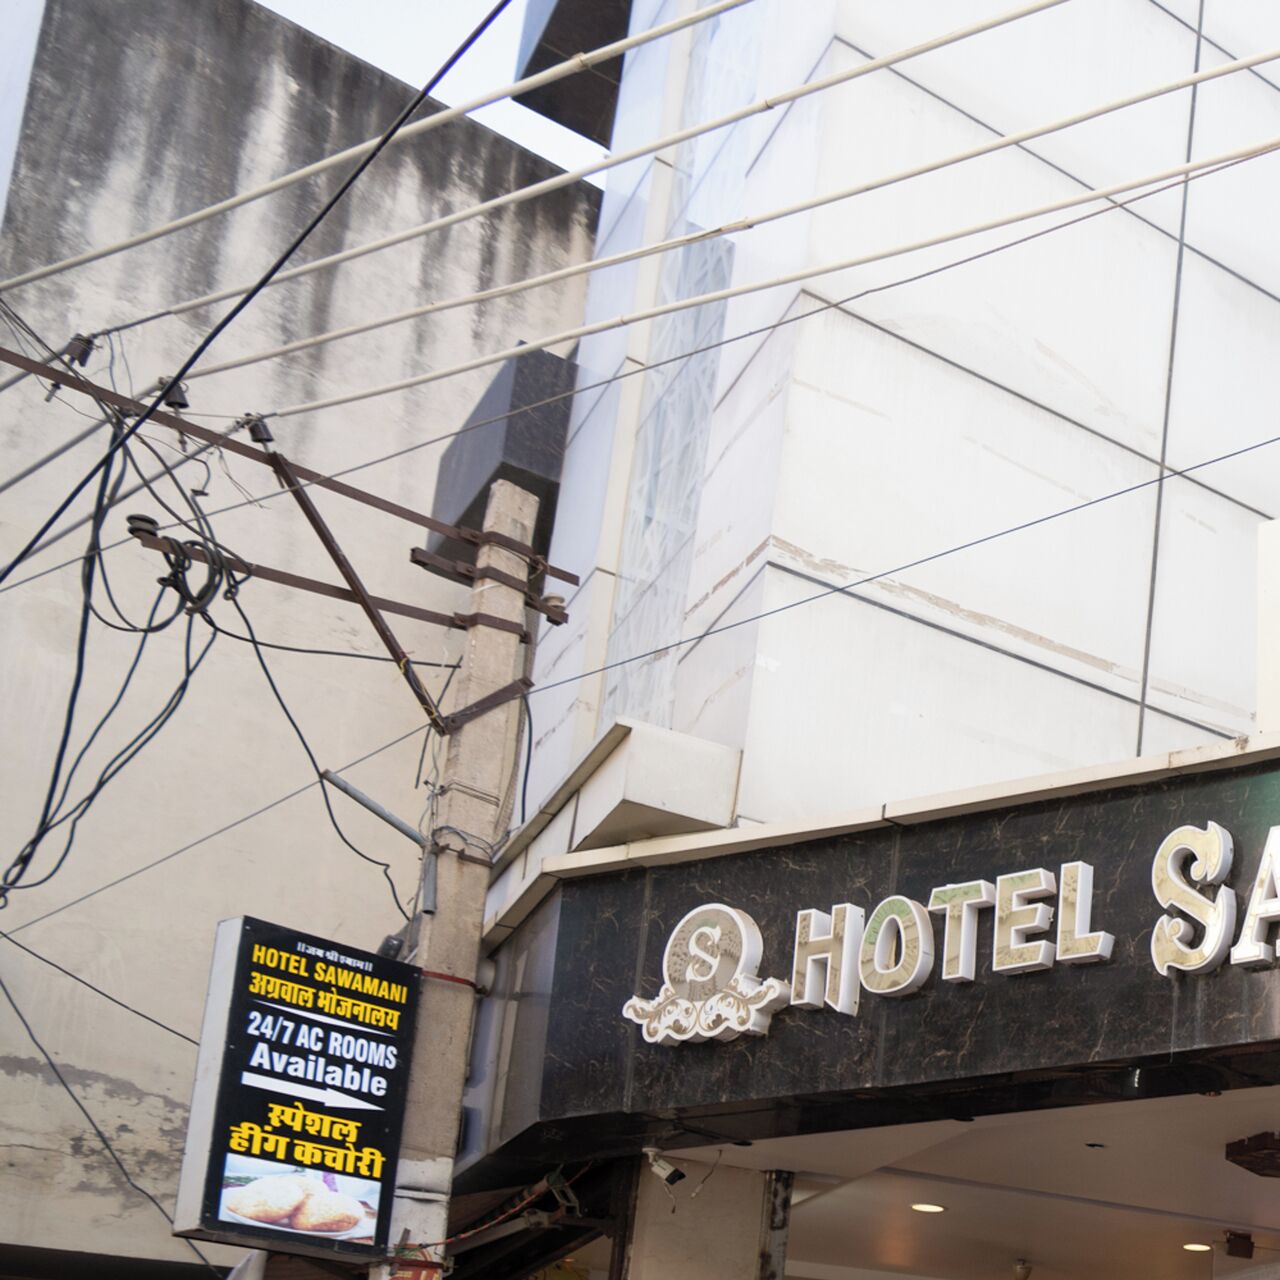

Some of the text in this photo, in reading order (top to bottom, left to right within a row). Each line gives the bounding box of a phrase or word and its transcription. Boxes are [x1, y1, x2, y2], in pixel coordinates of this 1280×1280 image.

[791, 861, 1114, 1016] HOTEL
[248, 970, 401, 1031] अग्रवाल भोजनालय
[252, 943, 408, 1004] HOTEL SAWAMANI
[247, 1010, 398, 1070] 24/7 AC ROOMS
[250, 1042, 388, 1097] Available
[229, 1121, 387, 1179] हींग कचोरी
[268, 1101, 362, 1144] स्पेशल
